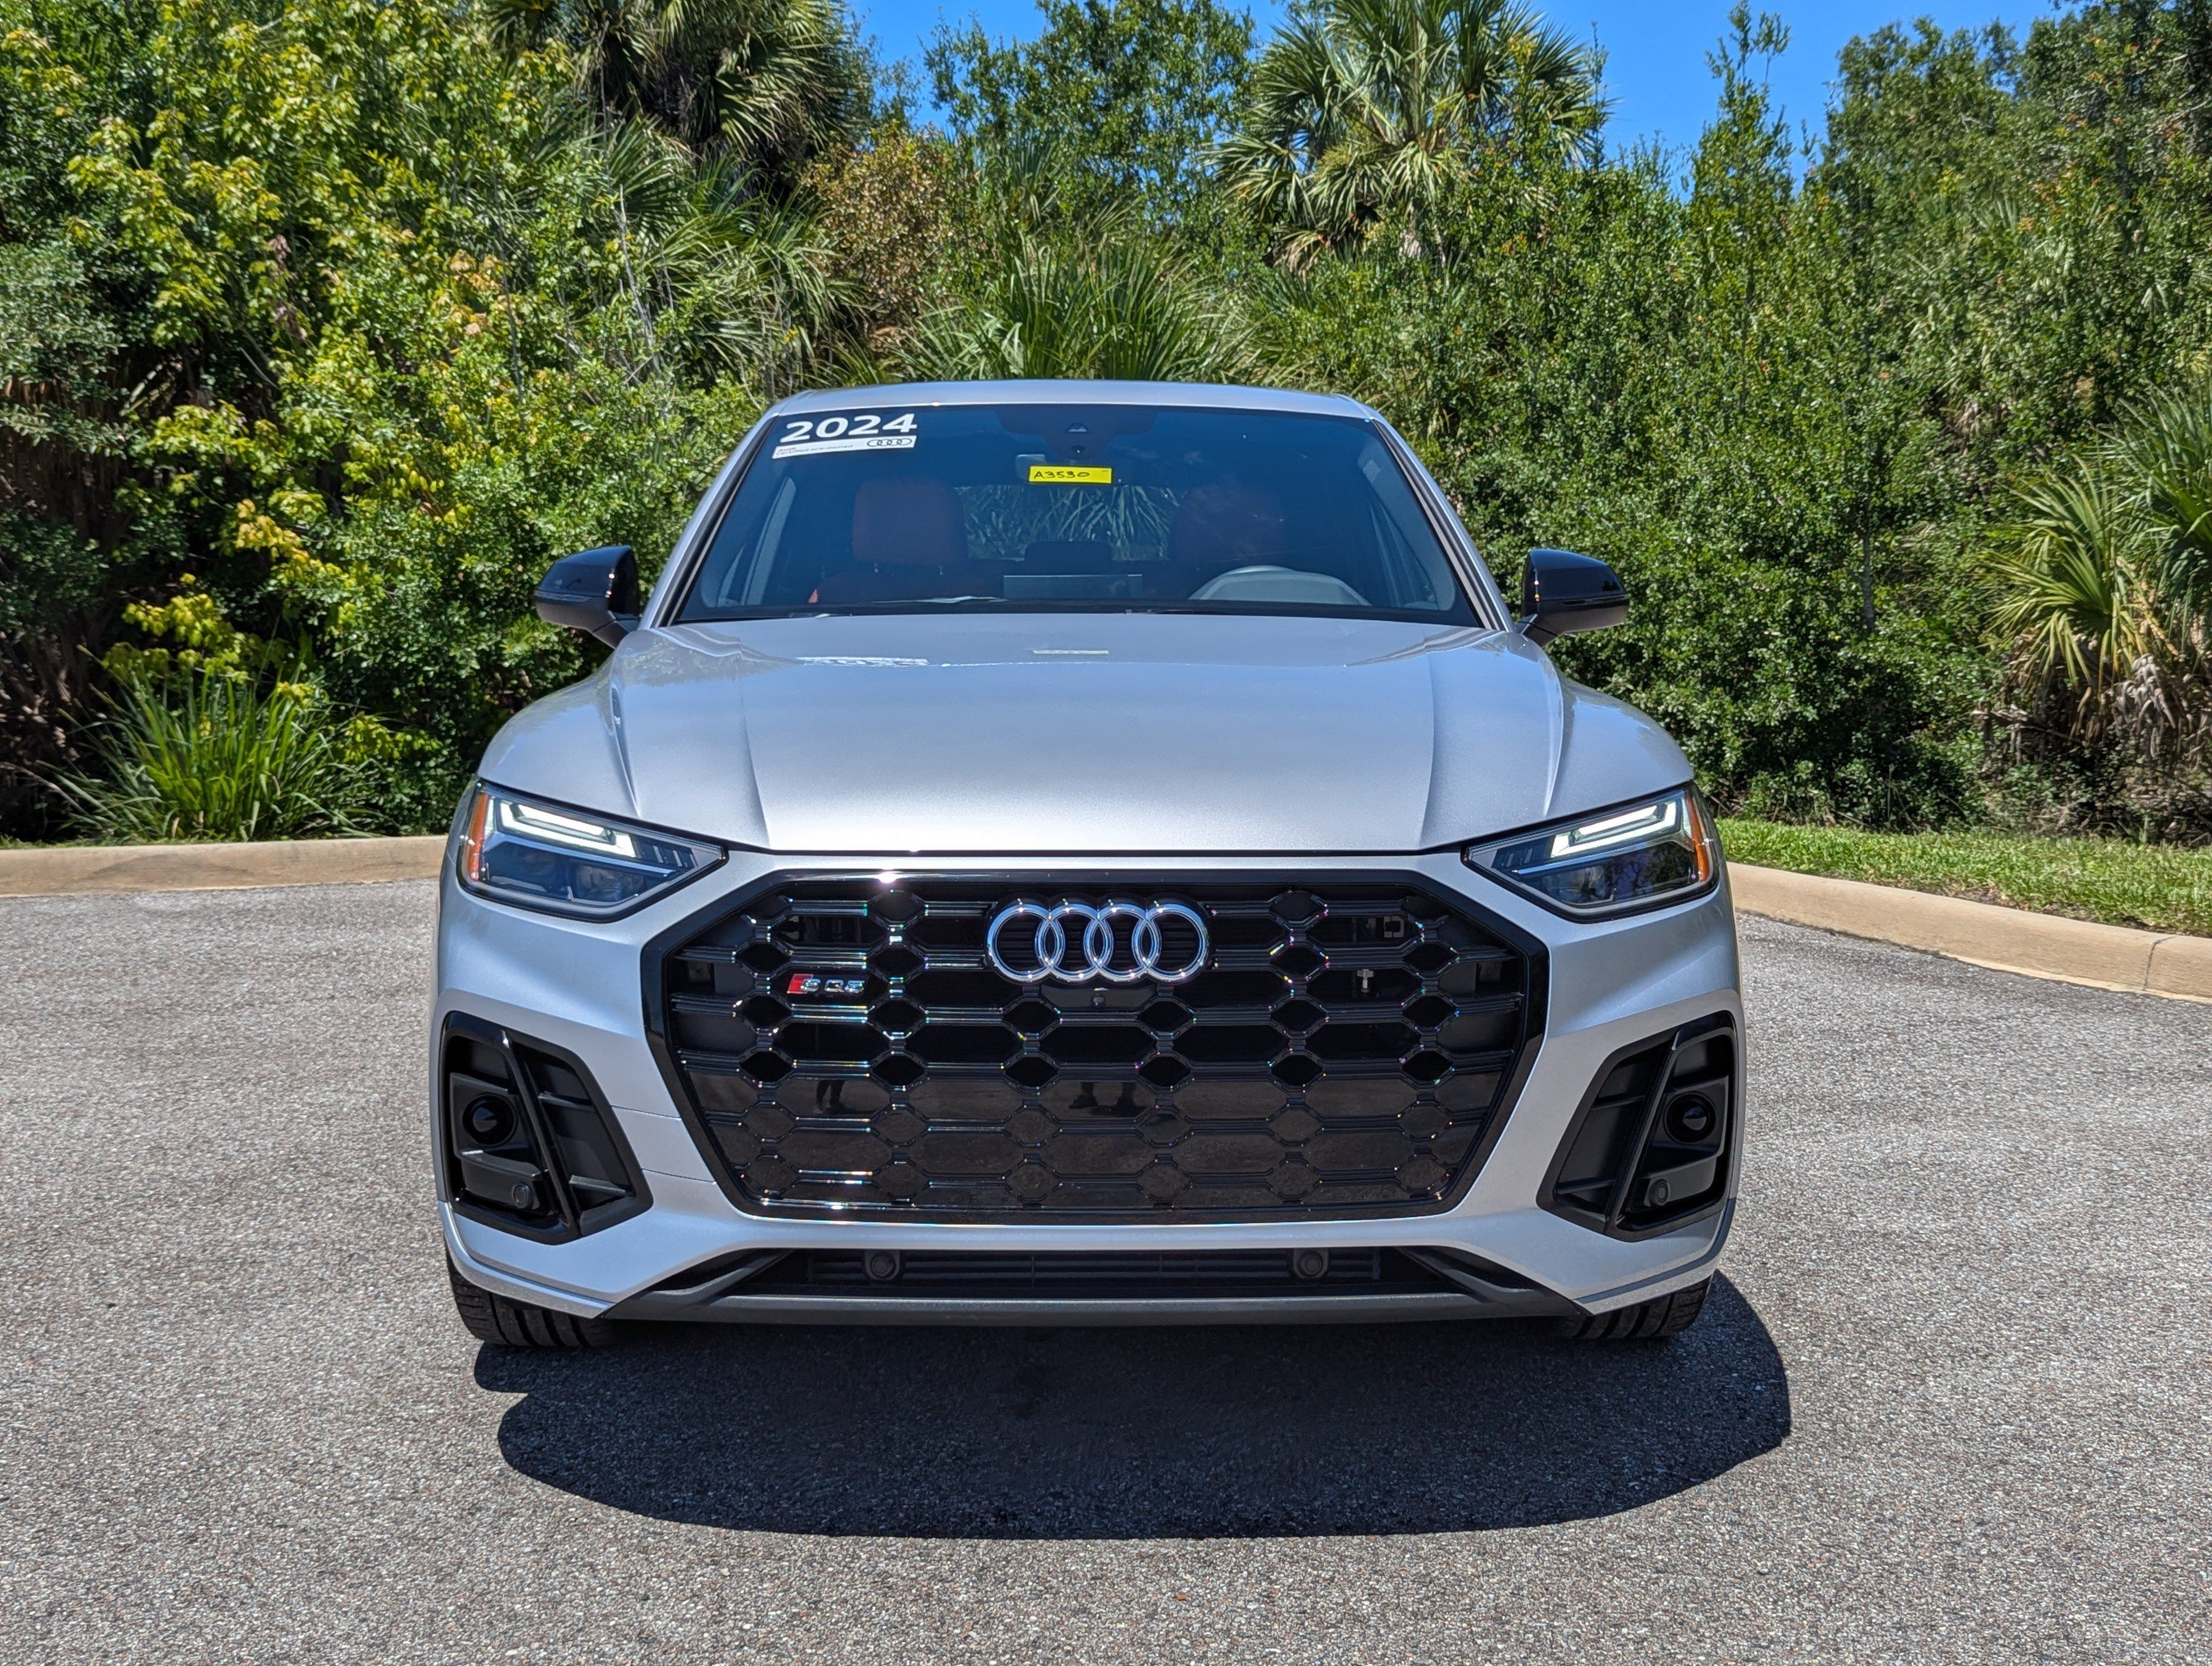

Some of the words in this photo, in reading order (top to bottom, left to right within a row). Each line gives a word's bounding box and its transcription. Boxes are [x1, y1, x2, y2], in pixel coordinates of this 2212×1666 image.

[780, 413, 917, 443] 2024
[1033, 471, 1090, 479] A3530
[800, 978, 865, 994] SQ5
